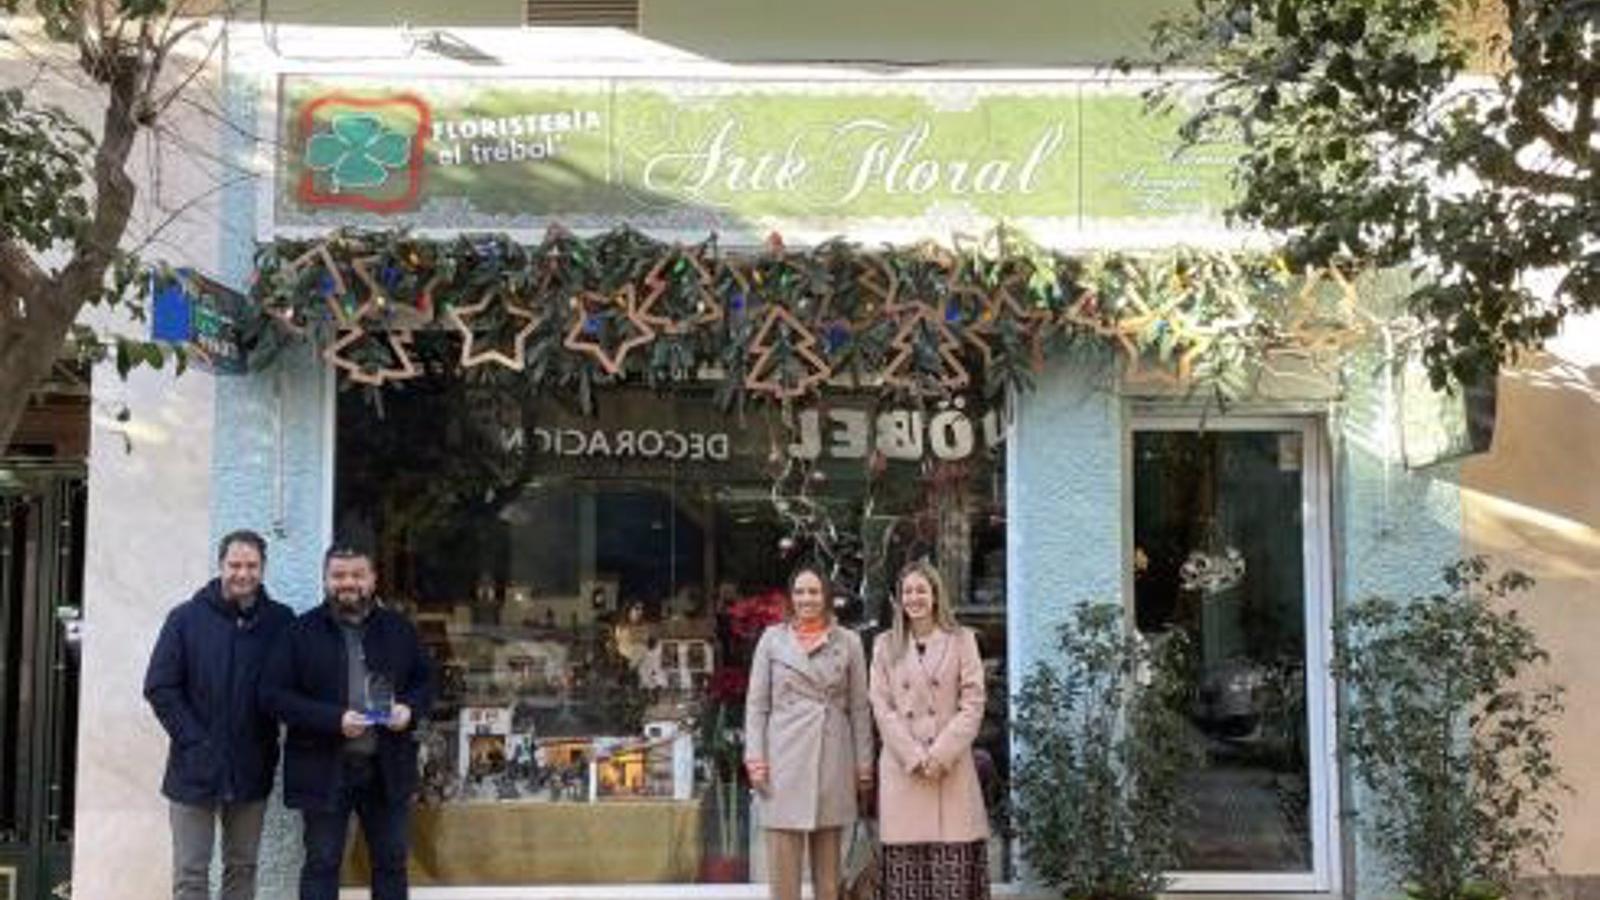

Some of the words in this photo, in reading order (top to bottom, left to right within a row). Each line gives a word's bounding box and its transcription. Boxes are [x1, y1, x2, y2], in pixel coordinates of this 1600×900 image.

[438, 144, 461, 165] el
[644, 117, 806, 204] Arte
[812, 117, 1065, 207] Floral
